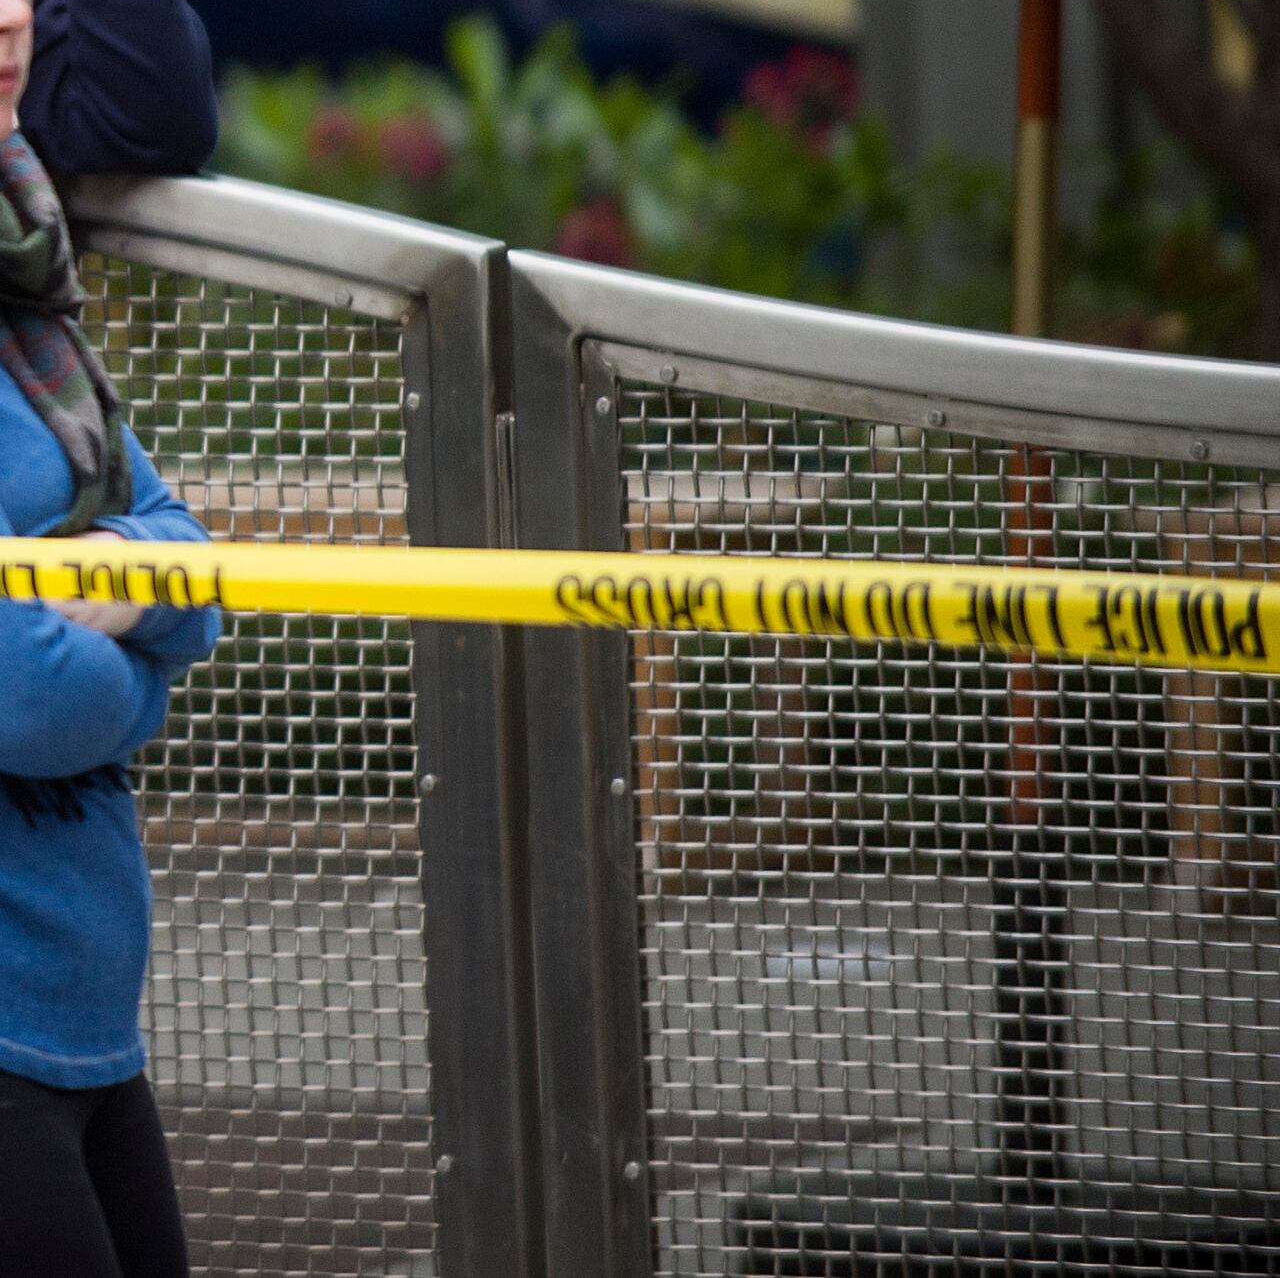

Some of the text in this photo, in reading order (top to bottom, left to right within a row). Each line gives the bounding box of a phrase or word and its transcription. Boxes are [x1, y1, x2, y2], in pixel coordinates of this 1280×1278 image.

[866, 581, 935, 644] DO
[951, 583, 1066, 652] LINE
[1080, 584, 1266, 660] POLICE
